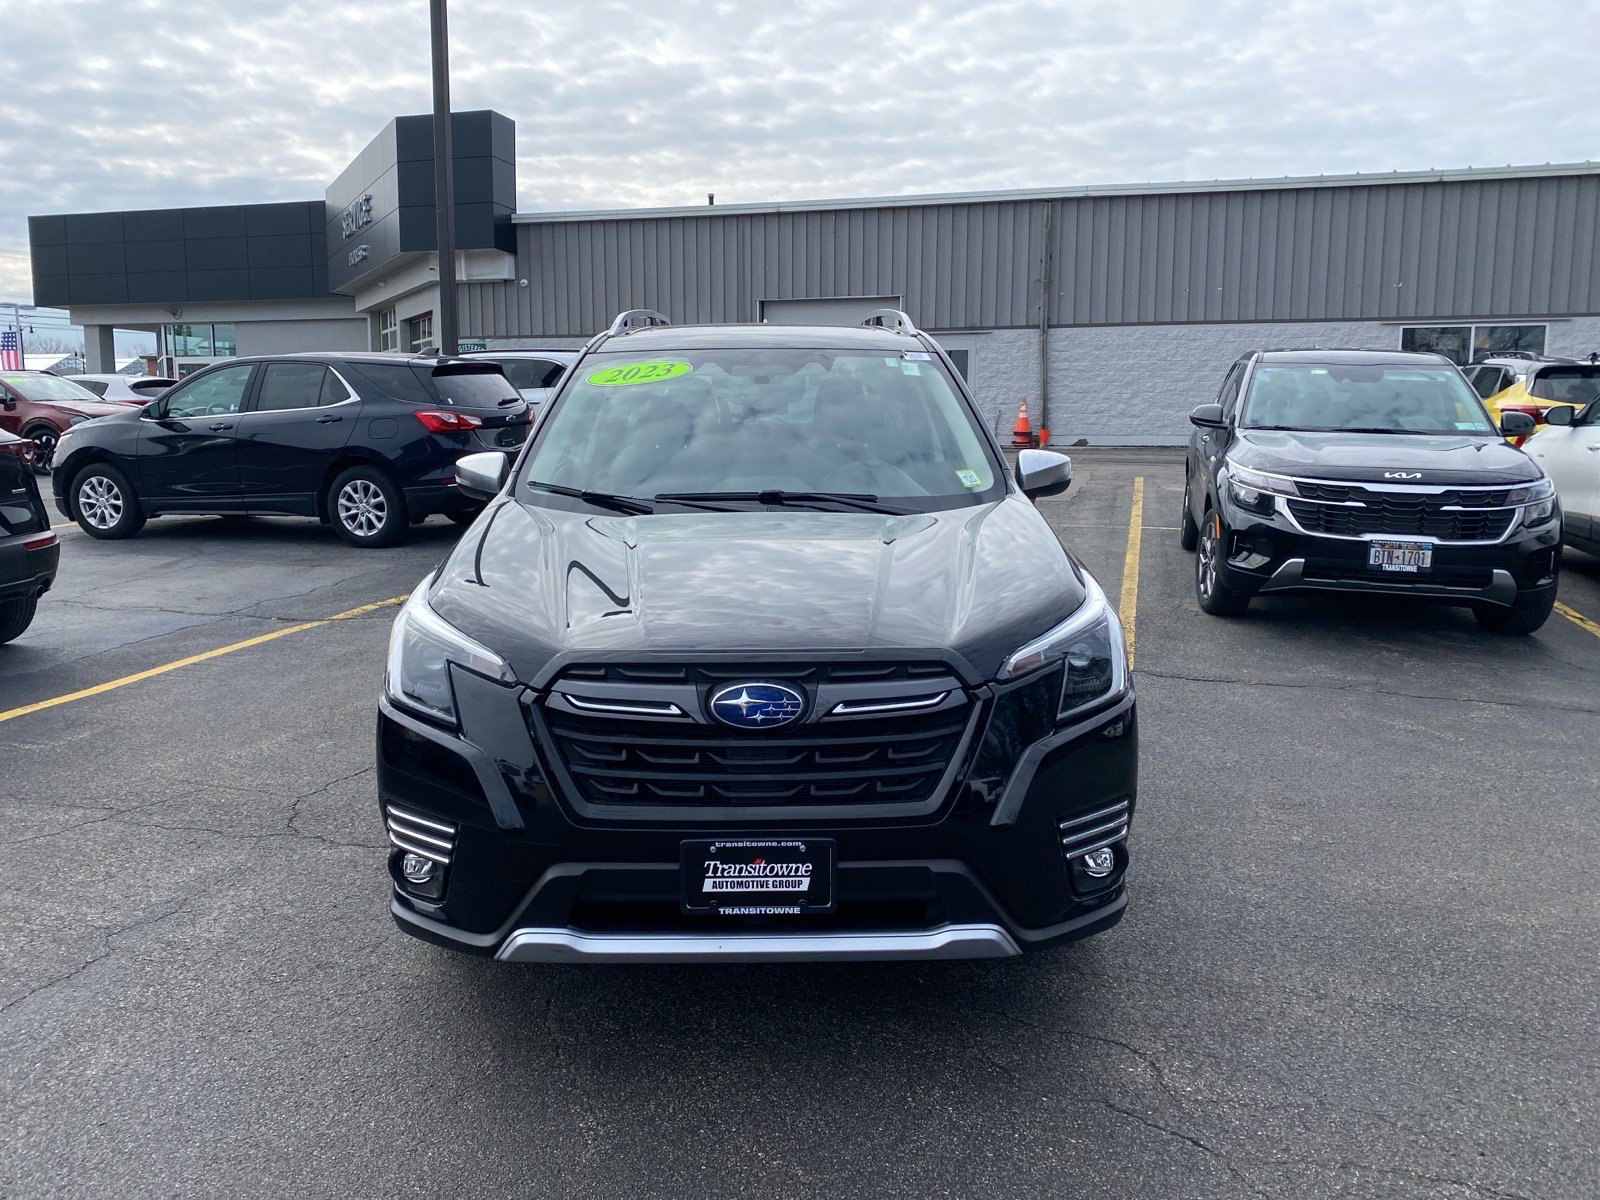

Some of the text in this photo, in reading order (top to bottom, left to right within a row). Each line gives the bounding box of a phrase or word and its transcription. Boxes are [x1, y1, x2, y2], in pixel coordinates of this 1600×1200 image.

[342, 194, 372, 239] SERVICE
[458, 344, 485, 353] GISTERE
[603, 363, 676, 383] 2023
[1382, 563, 1418, 573] TRANSITOWNE
[715, 840, 802, 848] transitowne.com
[704, 860, 813, 877] Transitowne
[711, 878, 803, 890] AUTOMOTIVE GROUP
[718, 906, 801, 915] TRANSITOWNE
